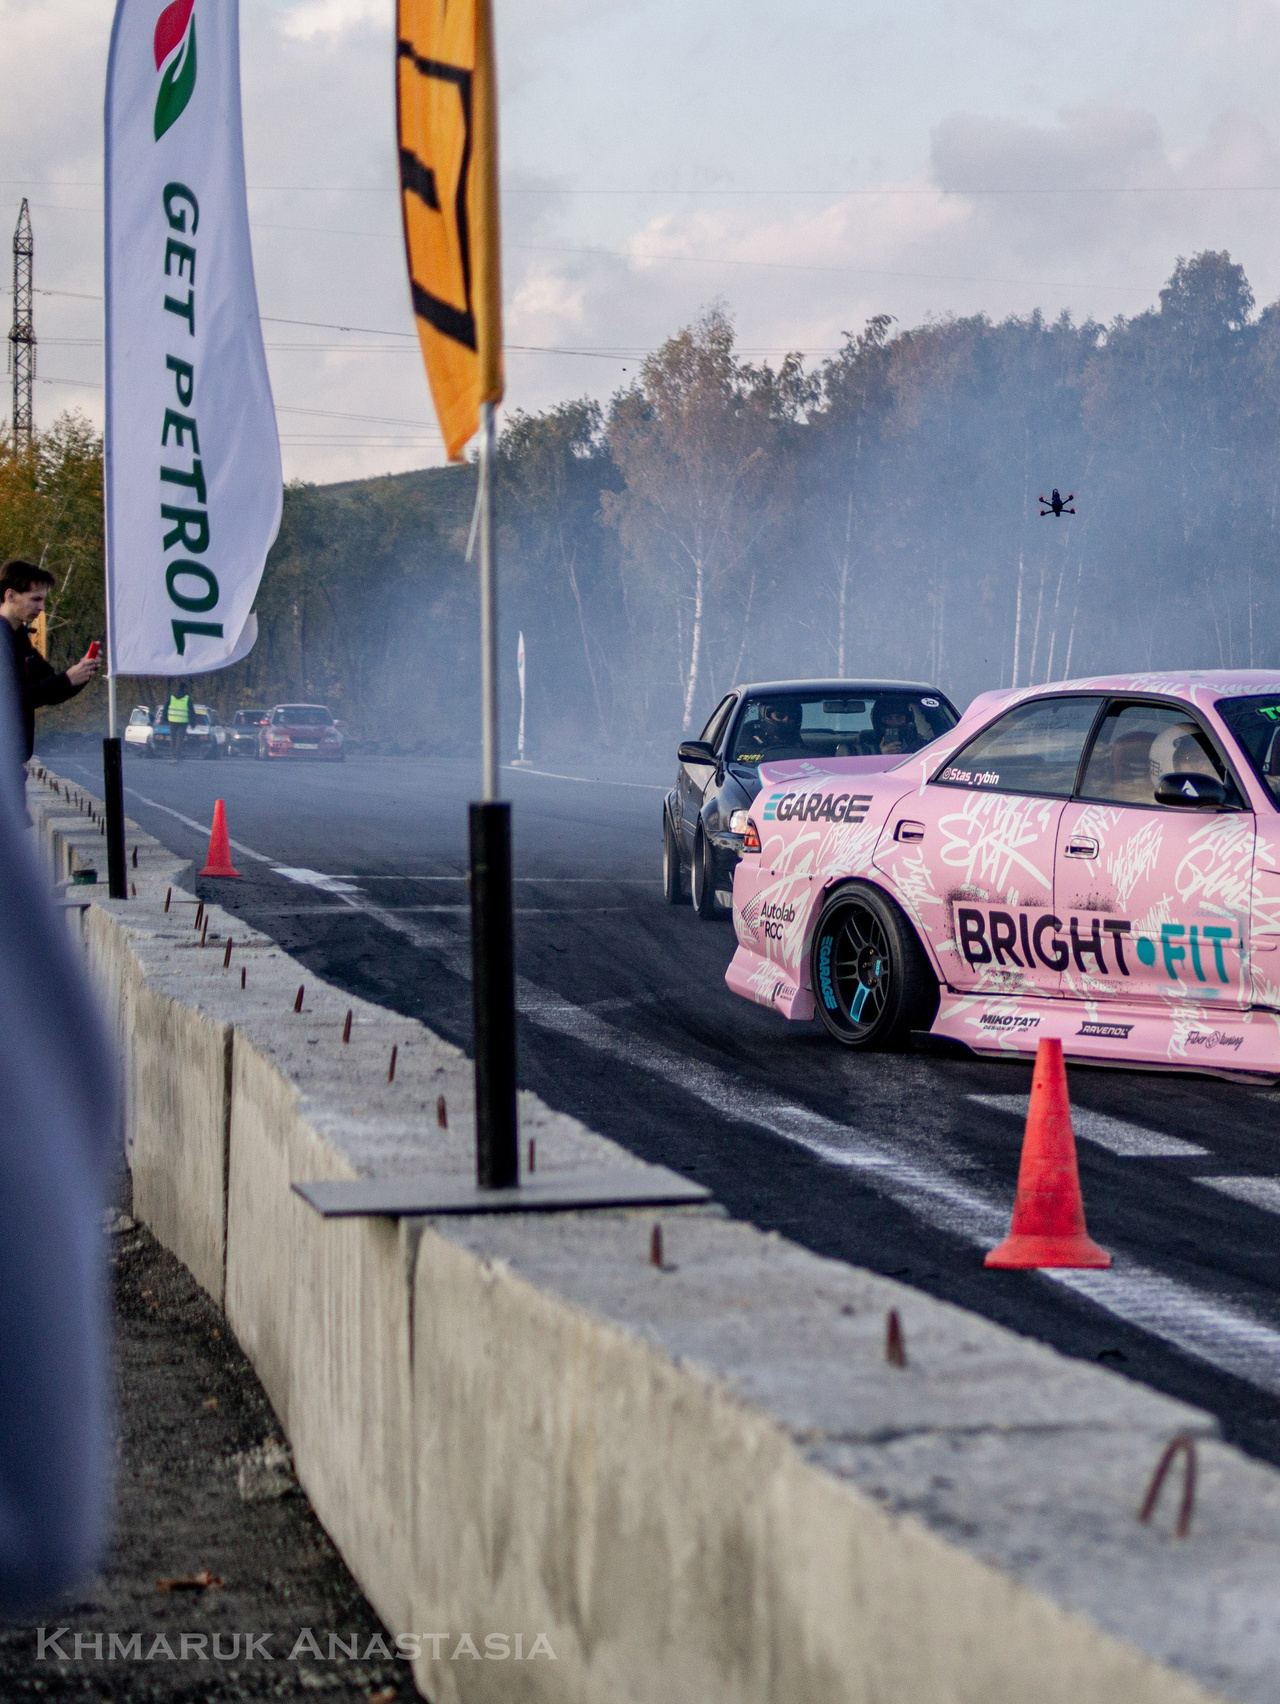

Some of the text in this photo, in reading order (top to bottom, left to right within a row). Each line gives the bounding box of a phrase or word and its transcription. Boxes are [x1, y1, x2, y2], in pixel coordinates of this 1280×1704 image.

[159, 181, 224, 656] GET PETROL
[761, 900, 796, 923] Autolab
[765, 920, 784, 941] RCC
[979, 1013, 1041, 1028] MIKOTATI
[1082, 1024, 1128, 1037] RAVENOL
